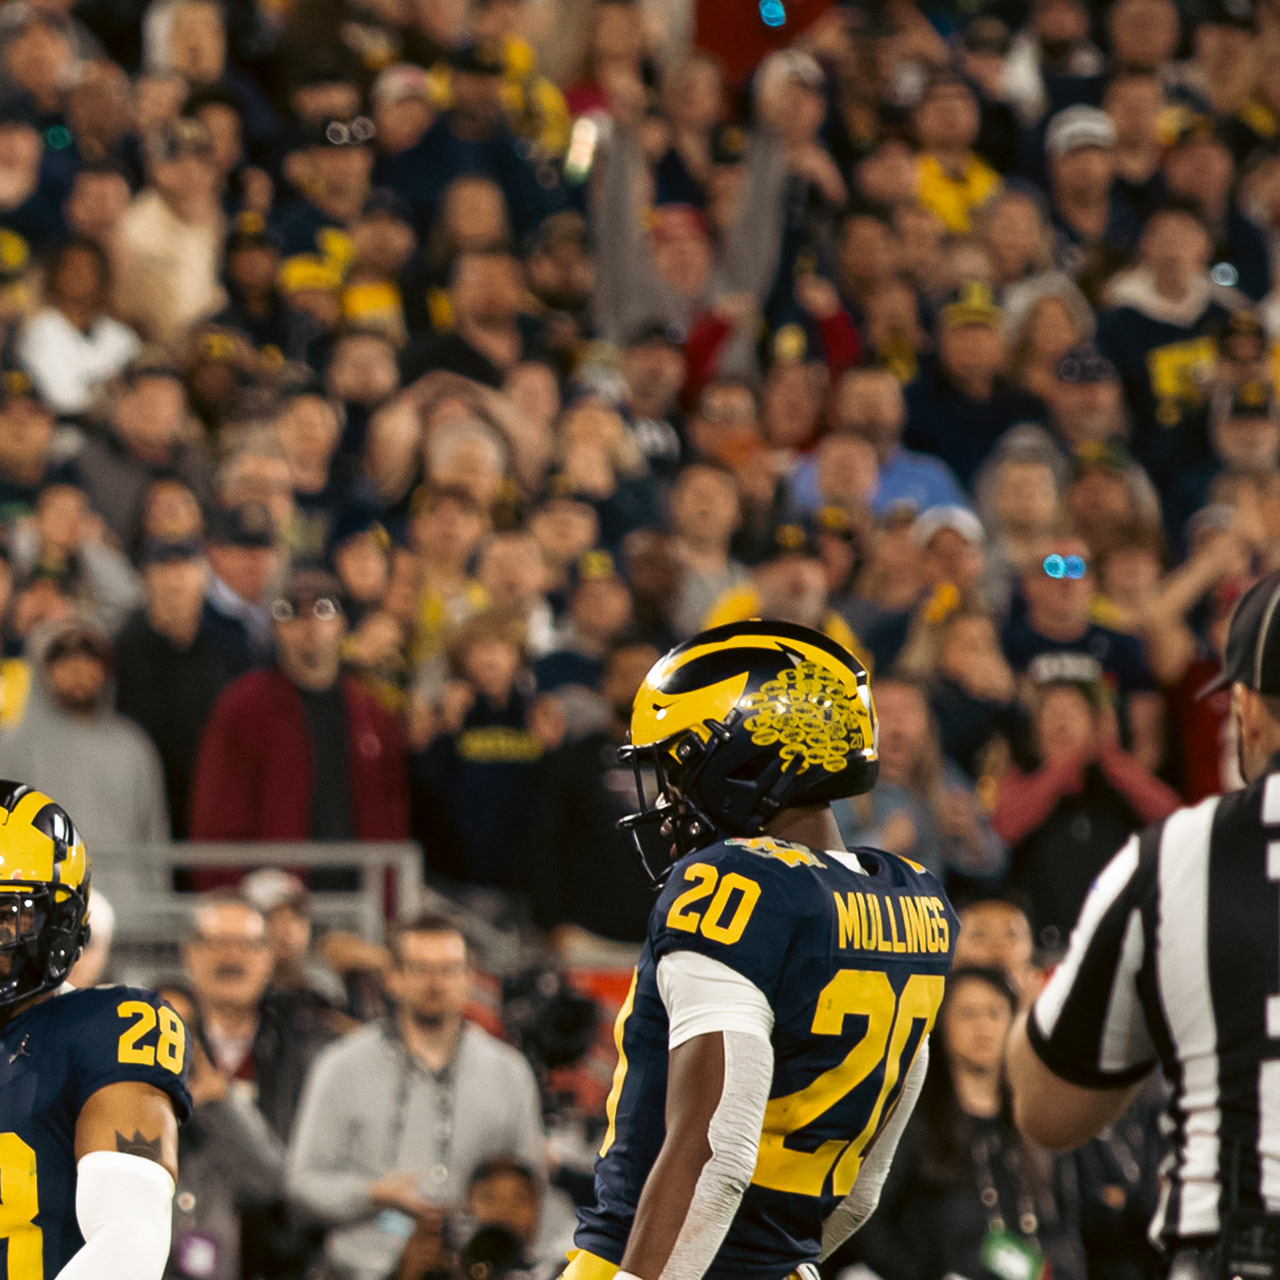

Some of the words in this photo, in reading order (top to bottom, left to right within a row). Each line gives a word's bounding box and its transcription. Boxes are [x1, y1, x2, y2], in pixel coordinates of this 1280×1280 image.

[666, 862, 762, 945] 20
[832, 891, 950, 953] MULLINGS
[116, 1000, 186, 1075] 28
[749, 968, 946, 1197] 20
